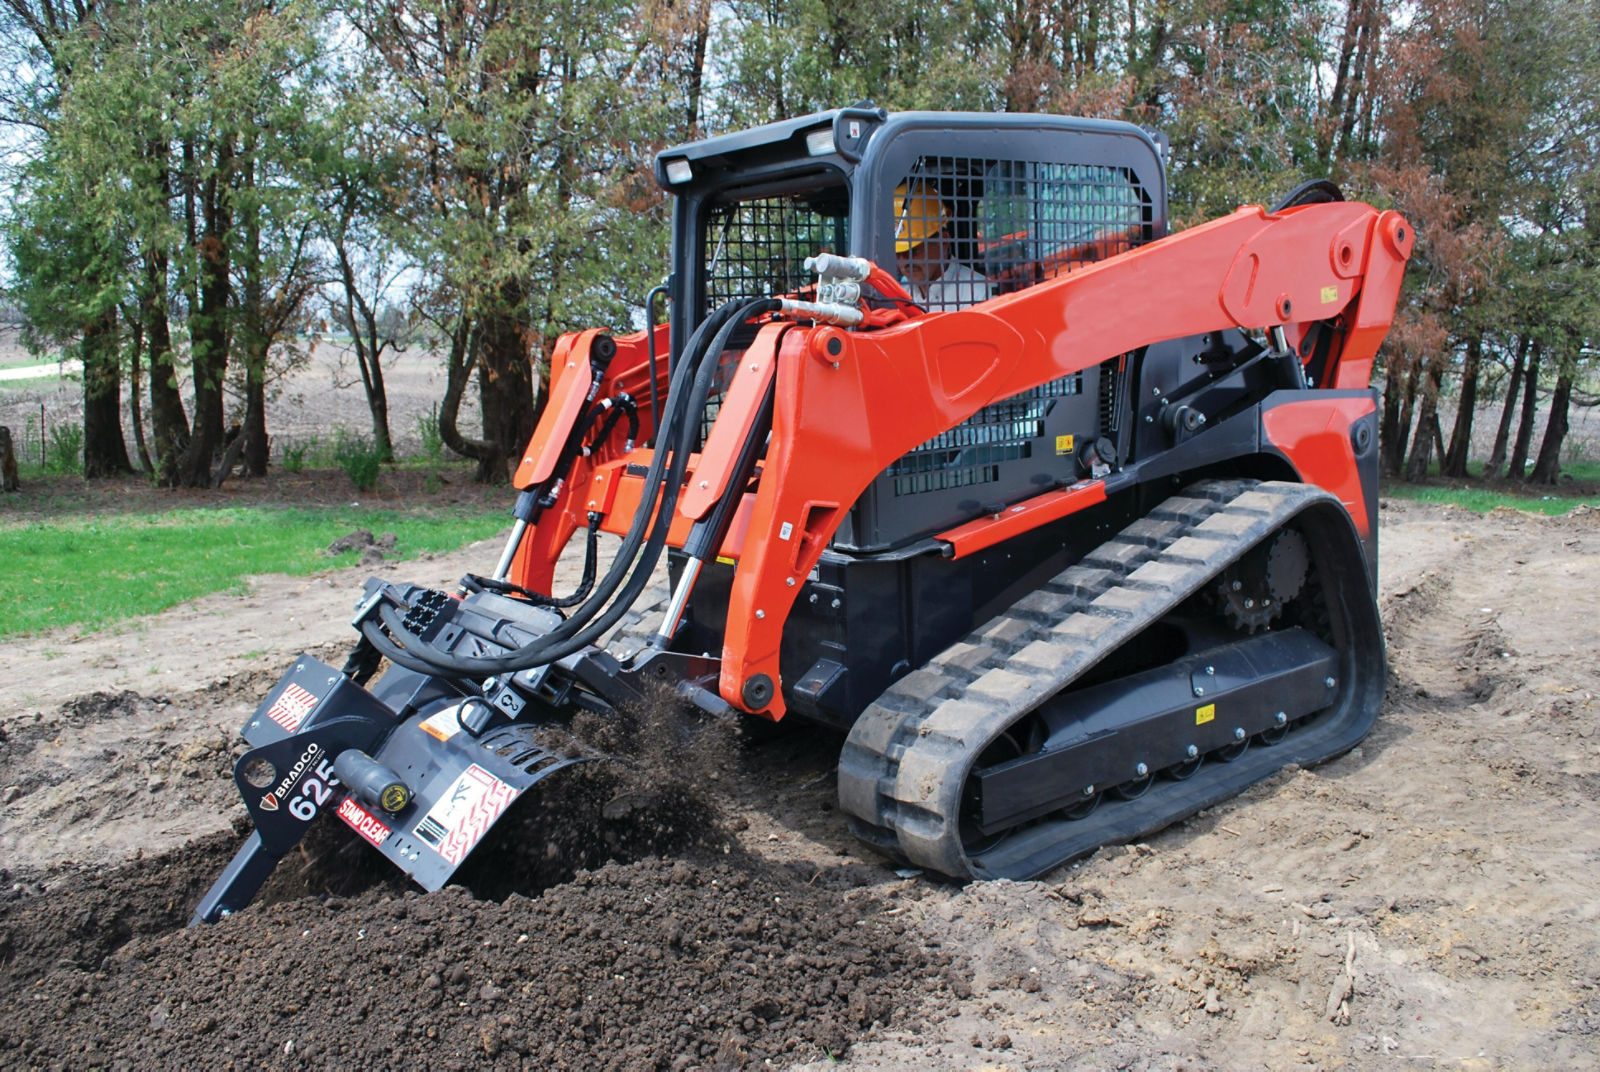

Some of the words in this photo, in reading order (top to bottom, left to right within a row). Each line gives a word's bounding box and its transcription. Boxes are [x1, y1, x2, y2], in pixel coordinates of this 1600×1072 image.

[275, 743, 318, 798] BRADCO
[288, 758, 340, 821] 625
[339, 799, 366, 826] STAND
[359, 816, 390, 845] CLEAR
[445, 831, 468, 858] NO
